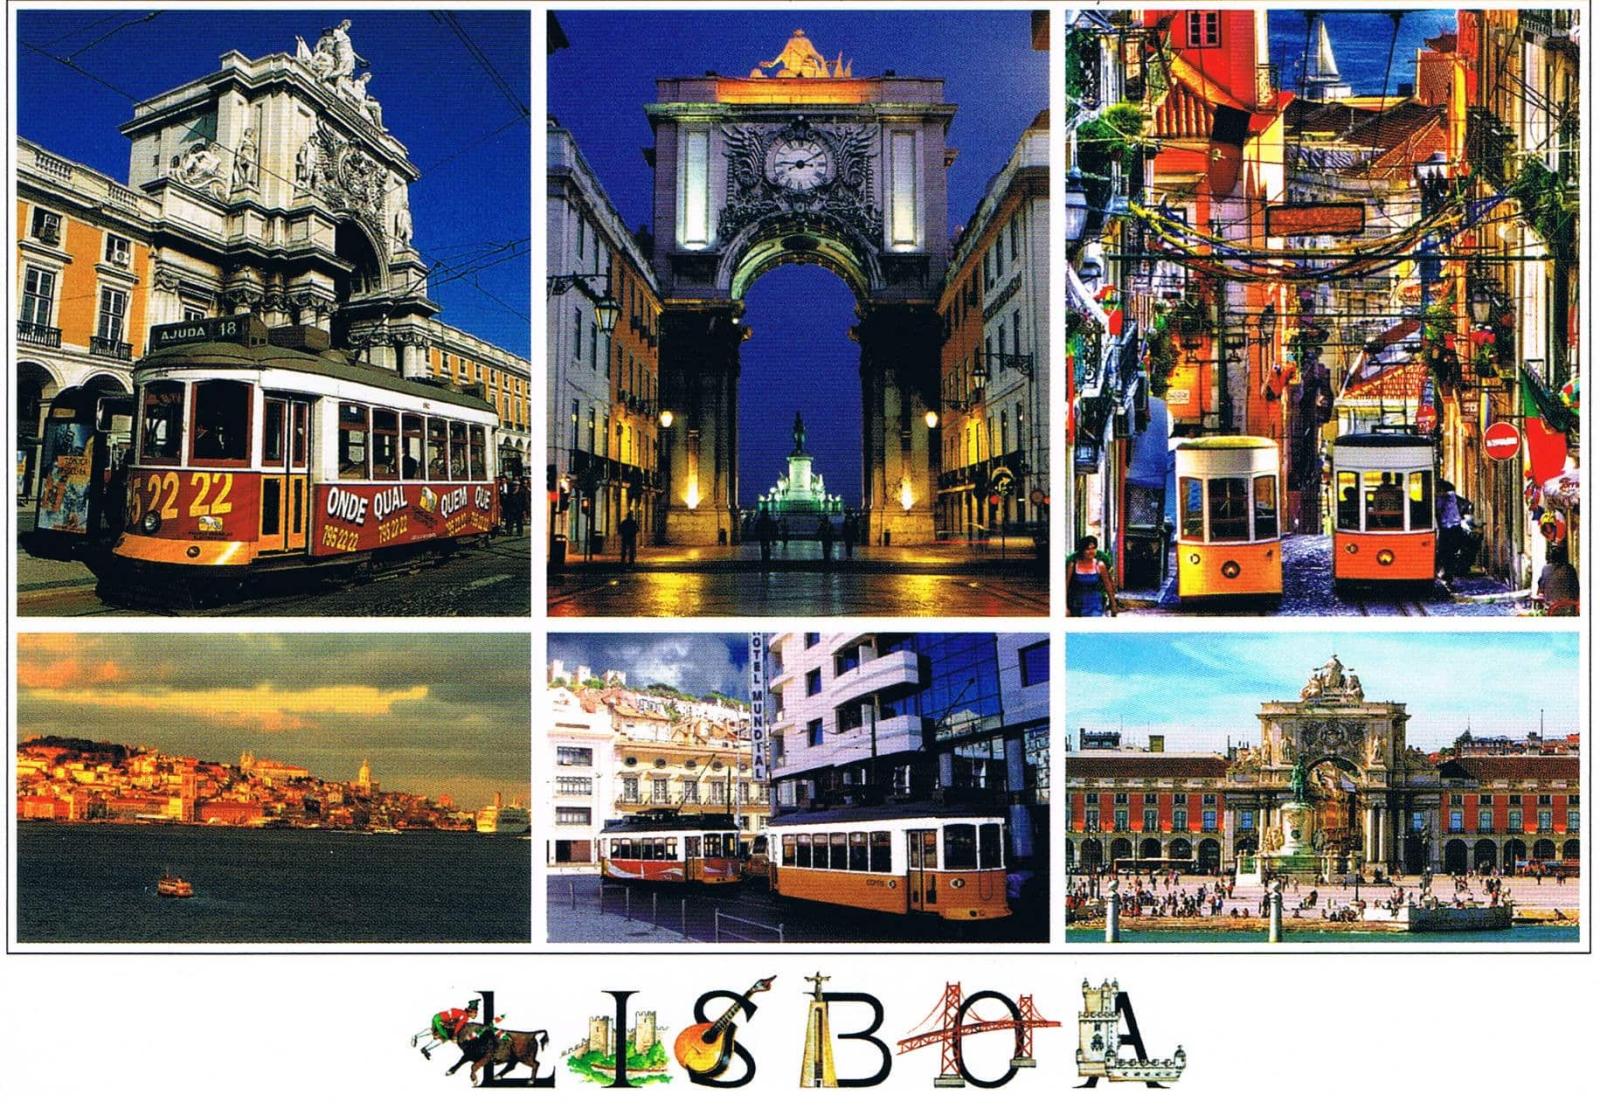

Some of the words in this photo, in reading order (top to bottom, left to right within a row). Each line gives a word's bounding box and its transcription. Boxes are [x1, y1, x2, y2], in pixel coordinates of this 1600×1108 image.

[161, 327, 206, 341] AJUDA
[219, 321, 236, 337] 18
[147, 472, 180, 520] 22
[189, 472, 233, 517] 22
[327, 486, 368, 525] ONDE
[374, 485, 408, 521] QUAL
[441, 486, 468, 519] QUEM
[475, 486, 491, 510] QUE
[753, 690, 763, 779] MUNDIAL
[472, 989, 1171, 1089] LISBOA
